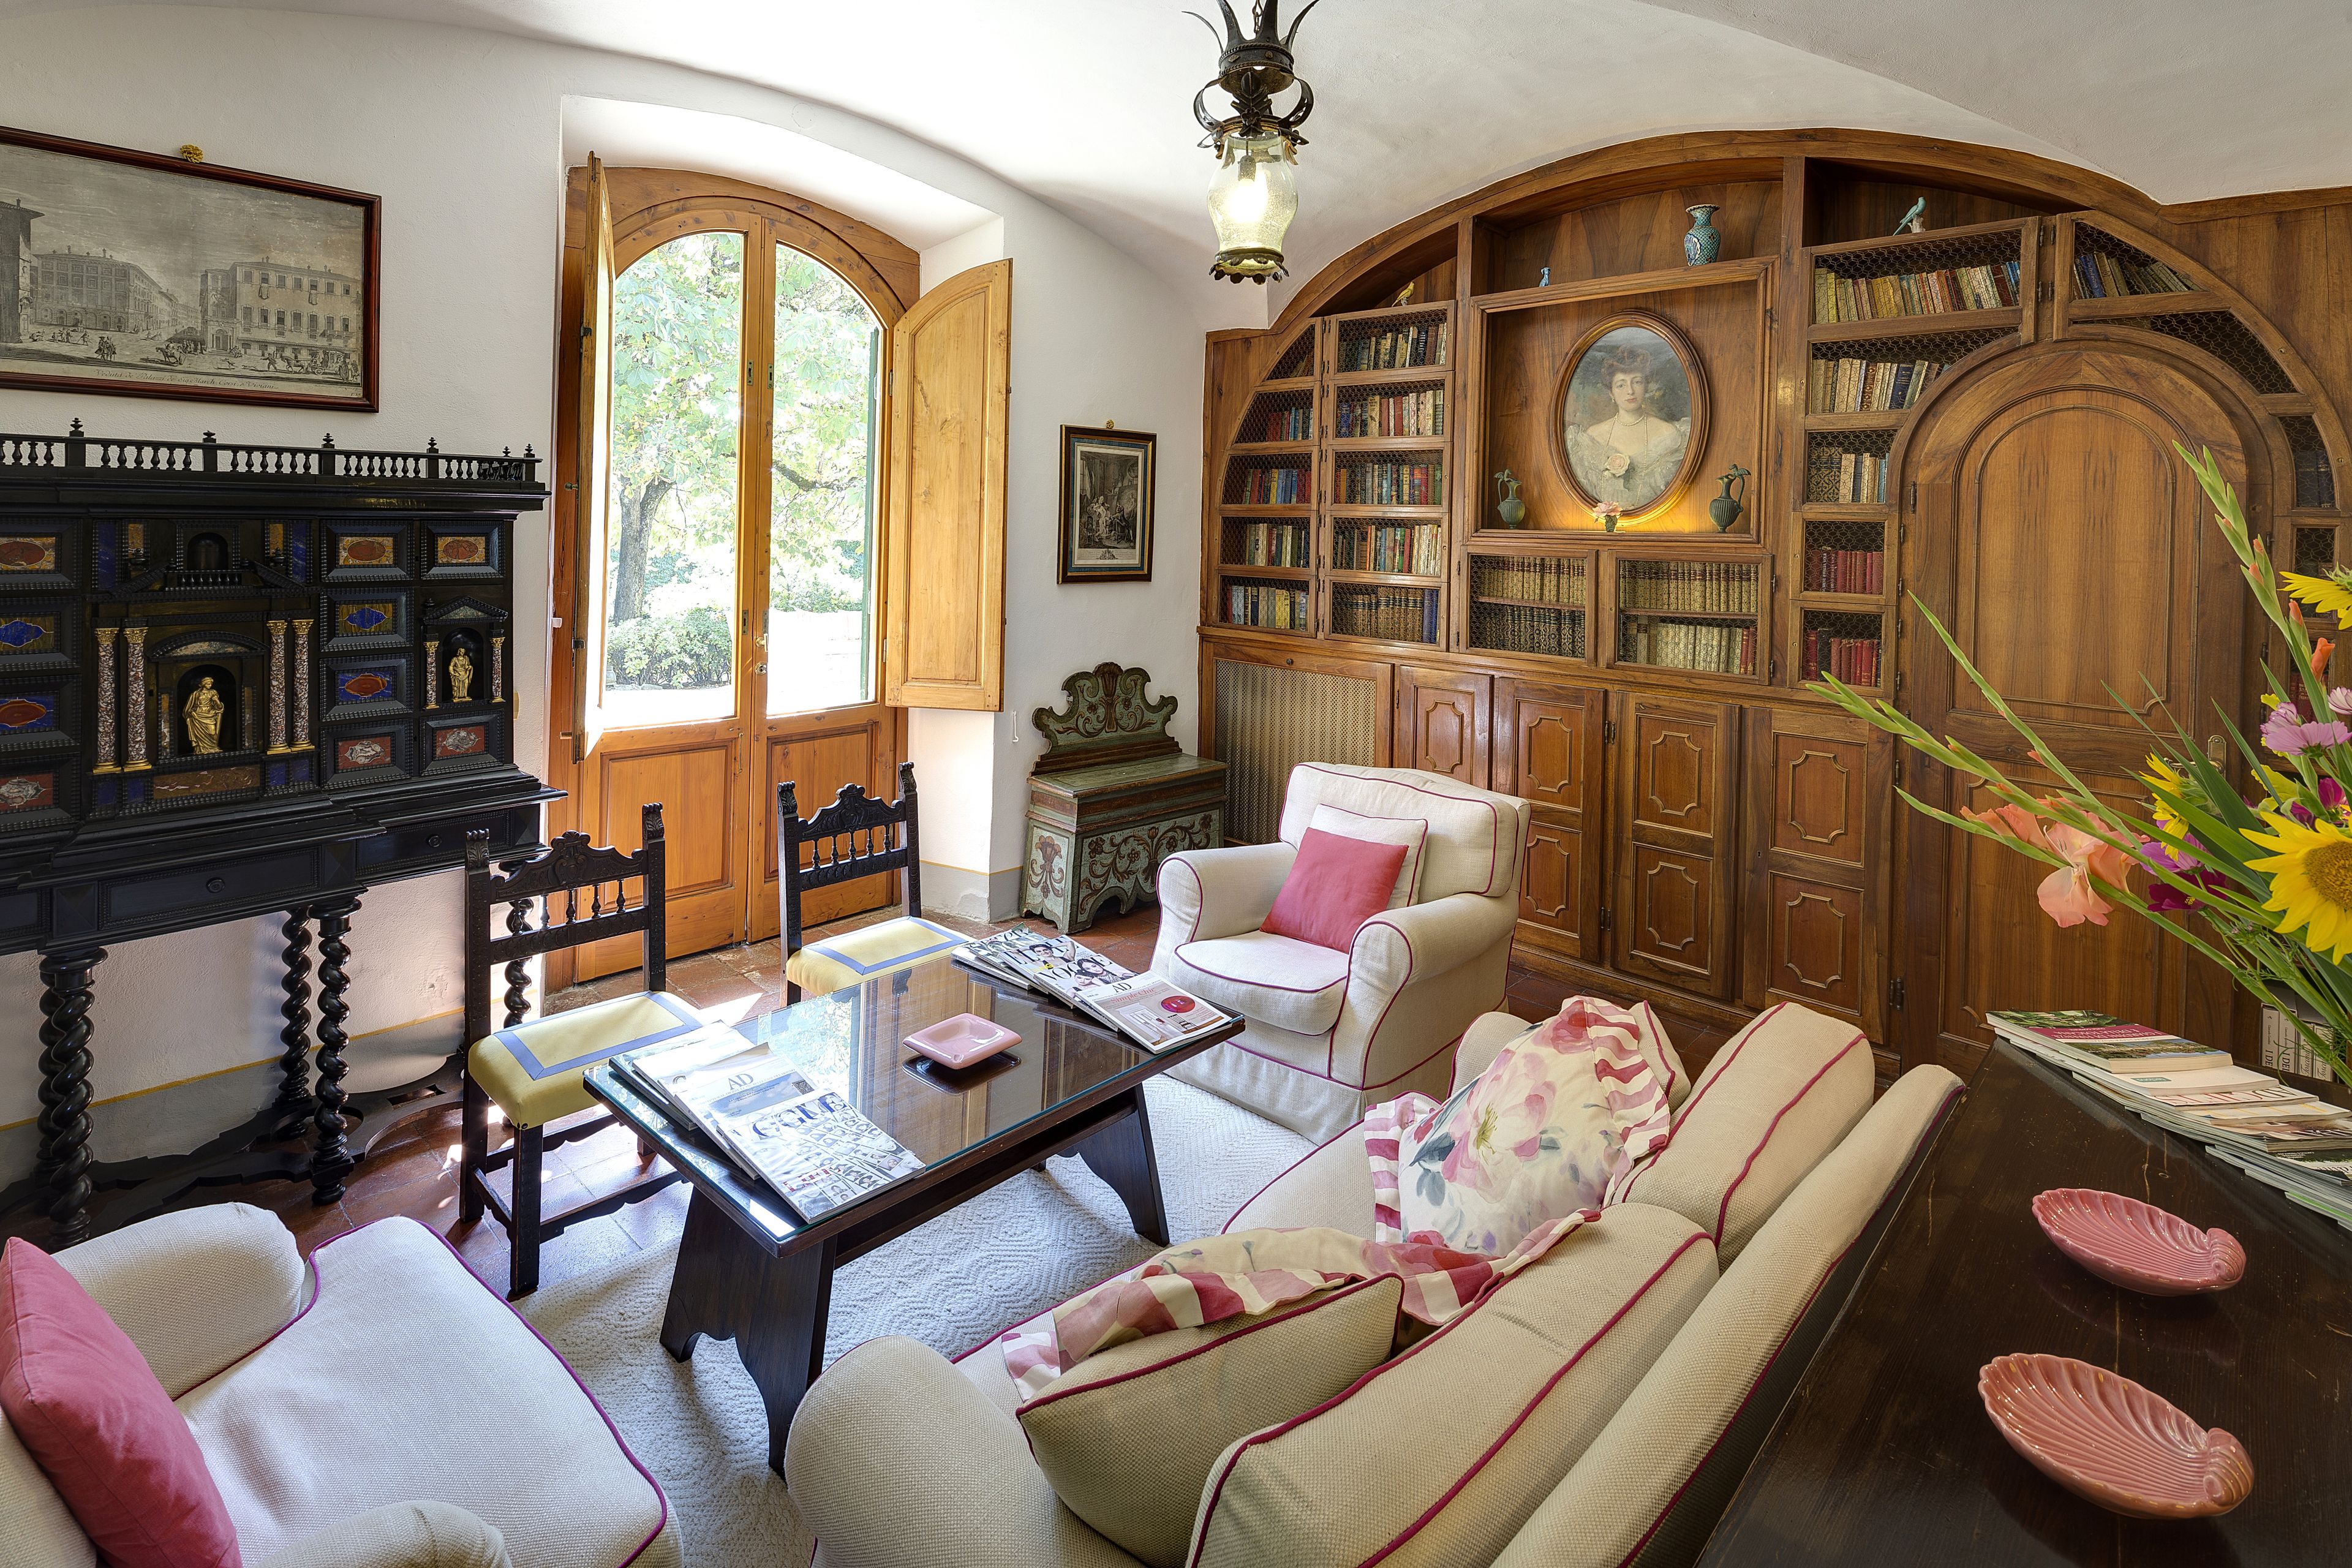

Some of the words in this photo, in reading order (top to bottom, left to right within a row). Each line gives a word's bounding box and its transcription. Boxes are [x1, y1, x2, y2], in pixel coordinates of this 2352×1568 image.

[1110, 992, 1137, 1004] Simple
[1138, 986, 1156, 995] Chic
[1112, 982, 1132, 993] AD
[728, 1073, 754, 1090] AD
